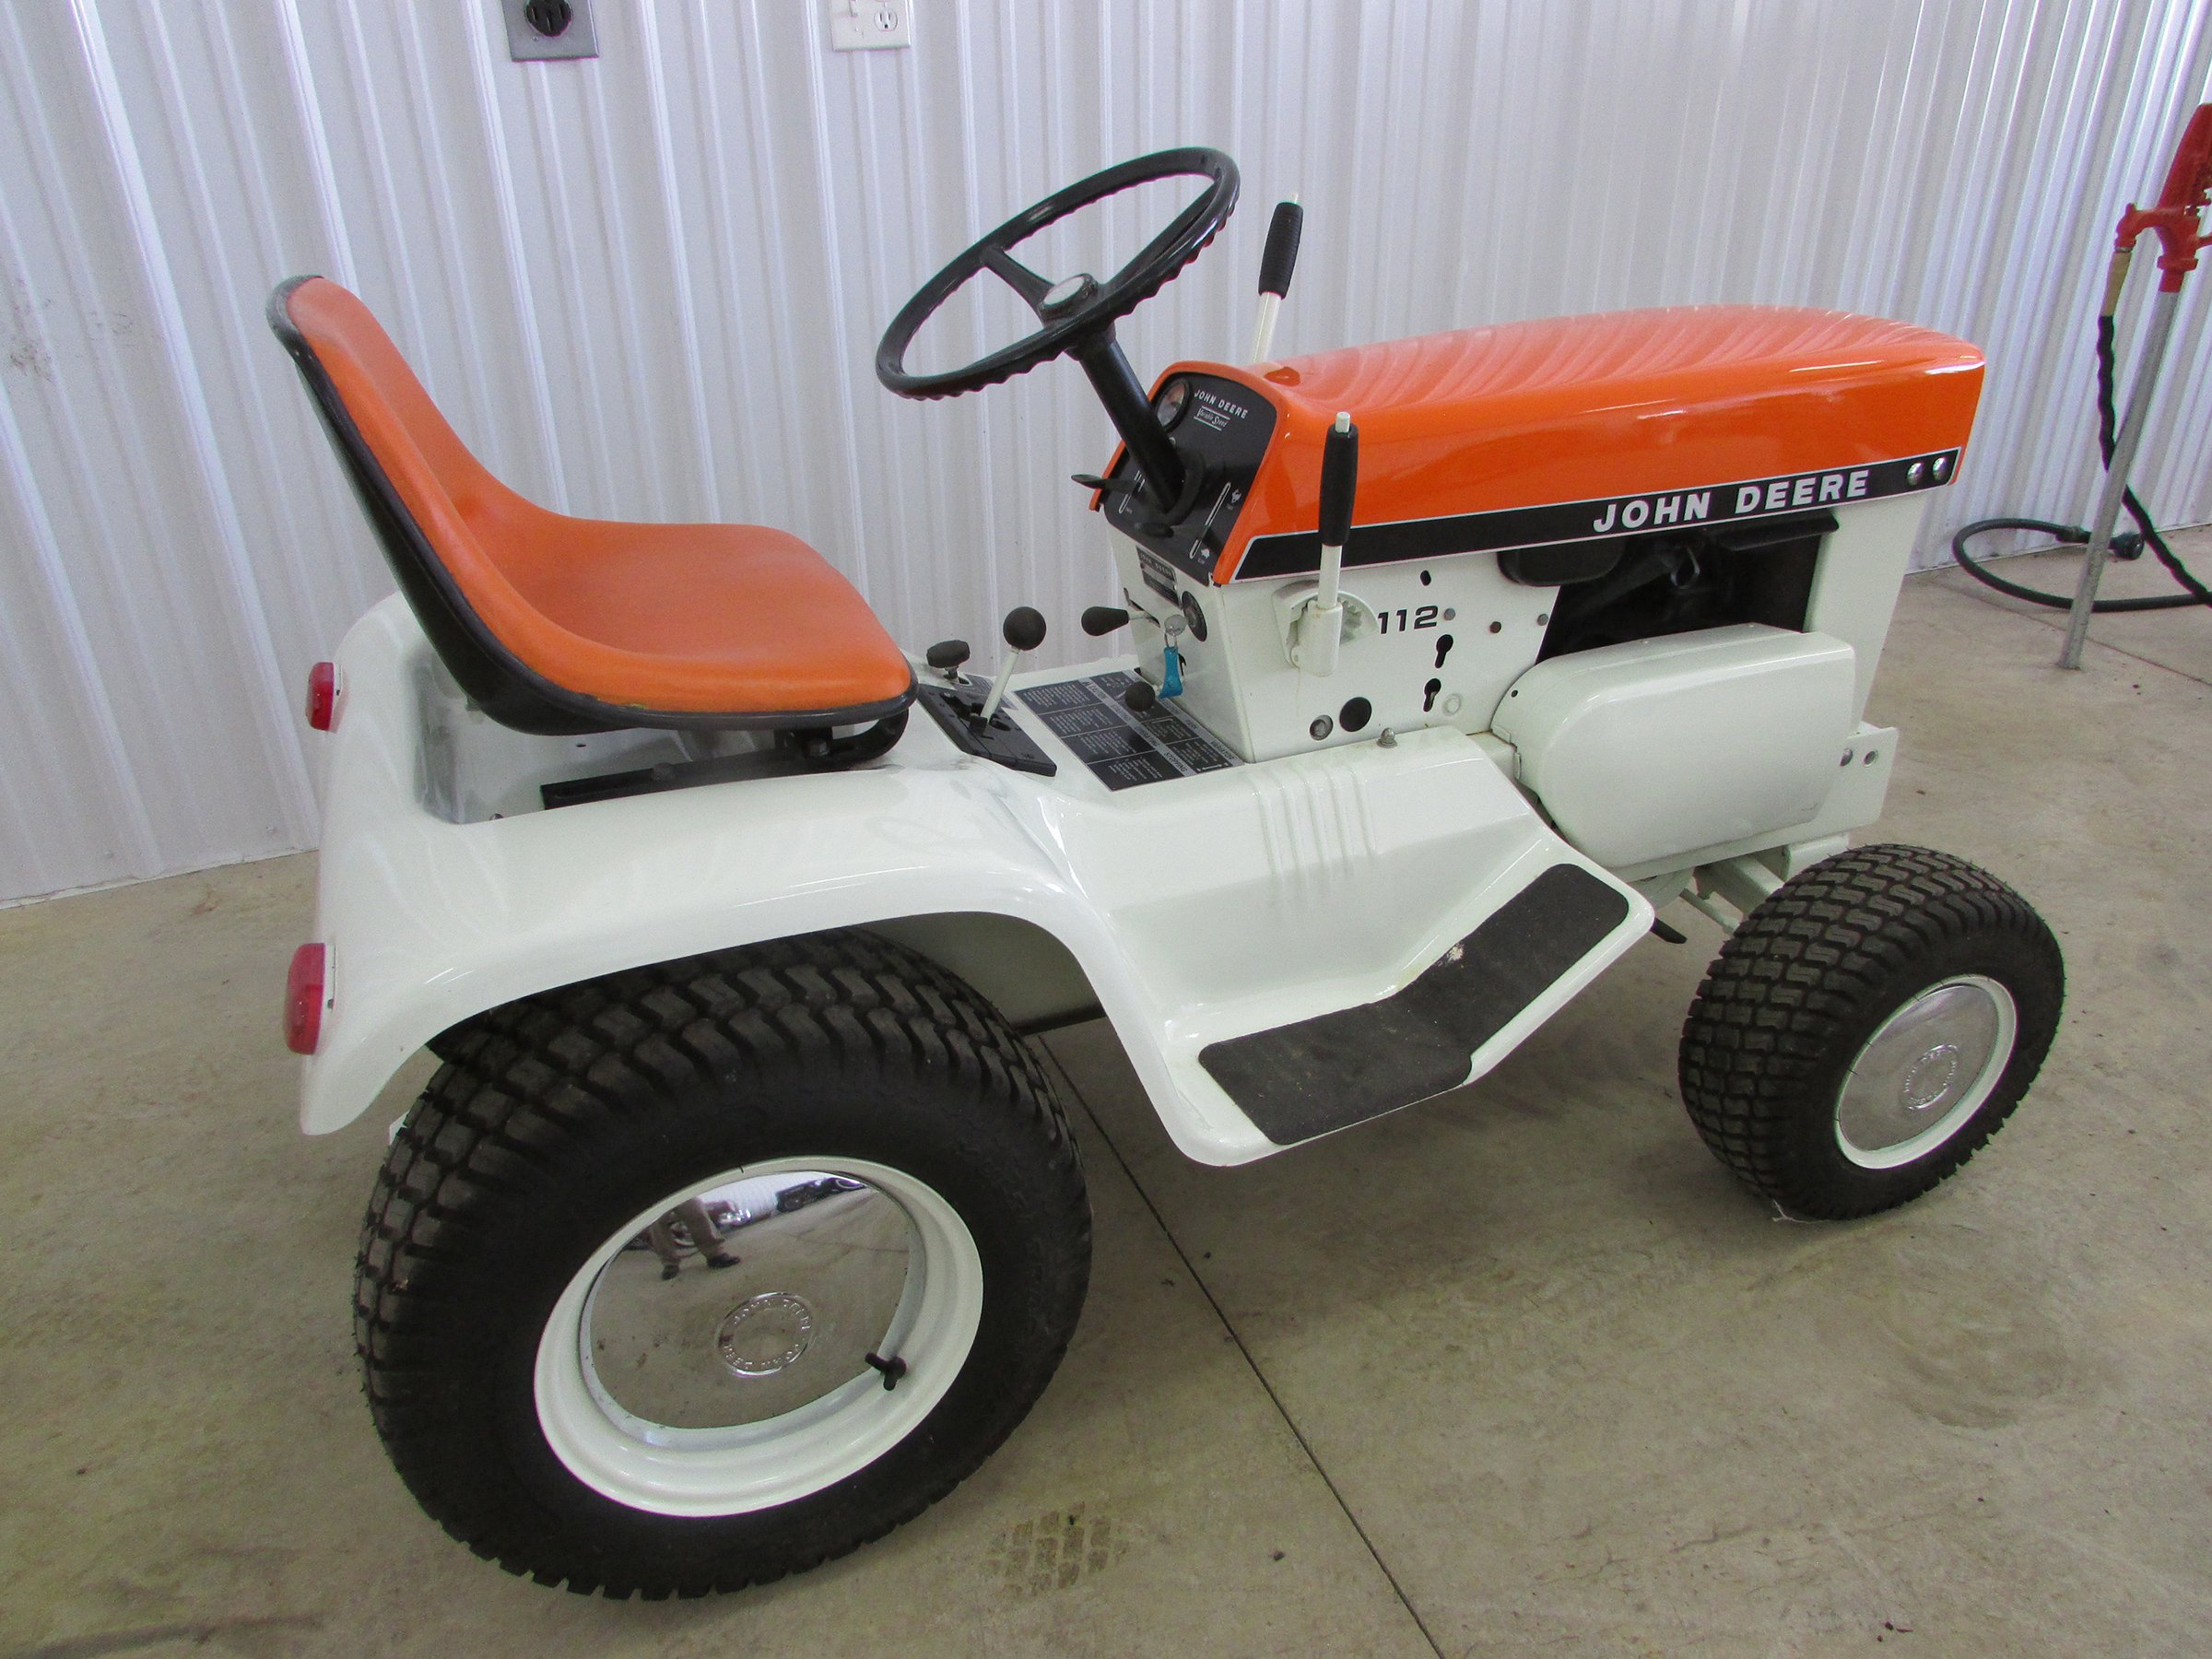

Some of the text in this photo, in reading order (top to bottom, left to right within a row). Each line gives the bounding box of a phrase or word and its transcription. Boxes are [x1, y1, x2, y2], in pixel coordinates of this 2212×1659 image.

[1194, 389, 1248, 419] JOHN DEERE
[1593, 470, 1869, 533] JOHN DEERE
[1378, 606, 1439, 634] 112
